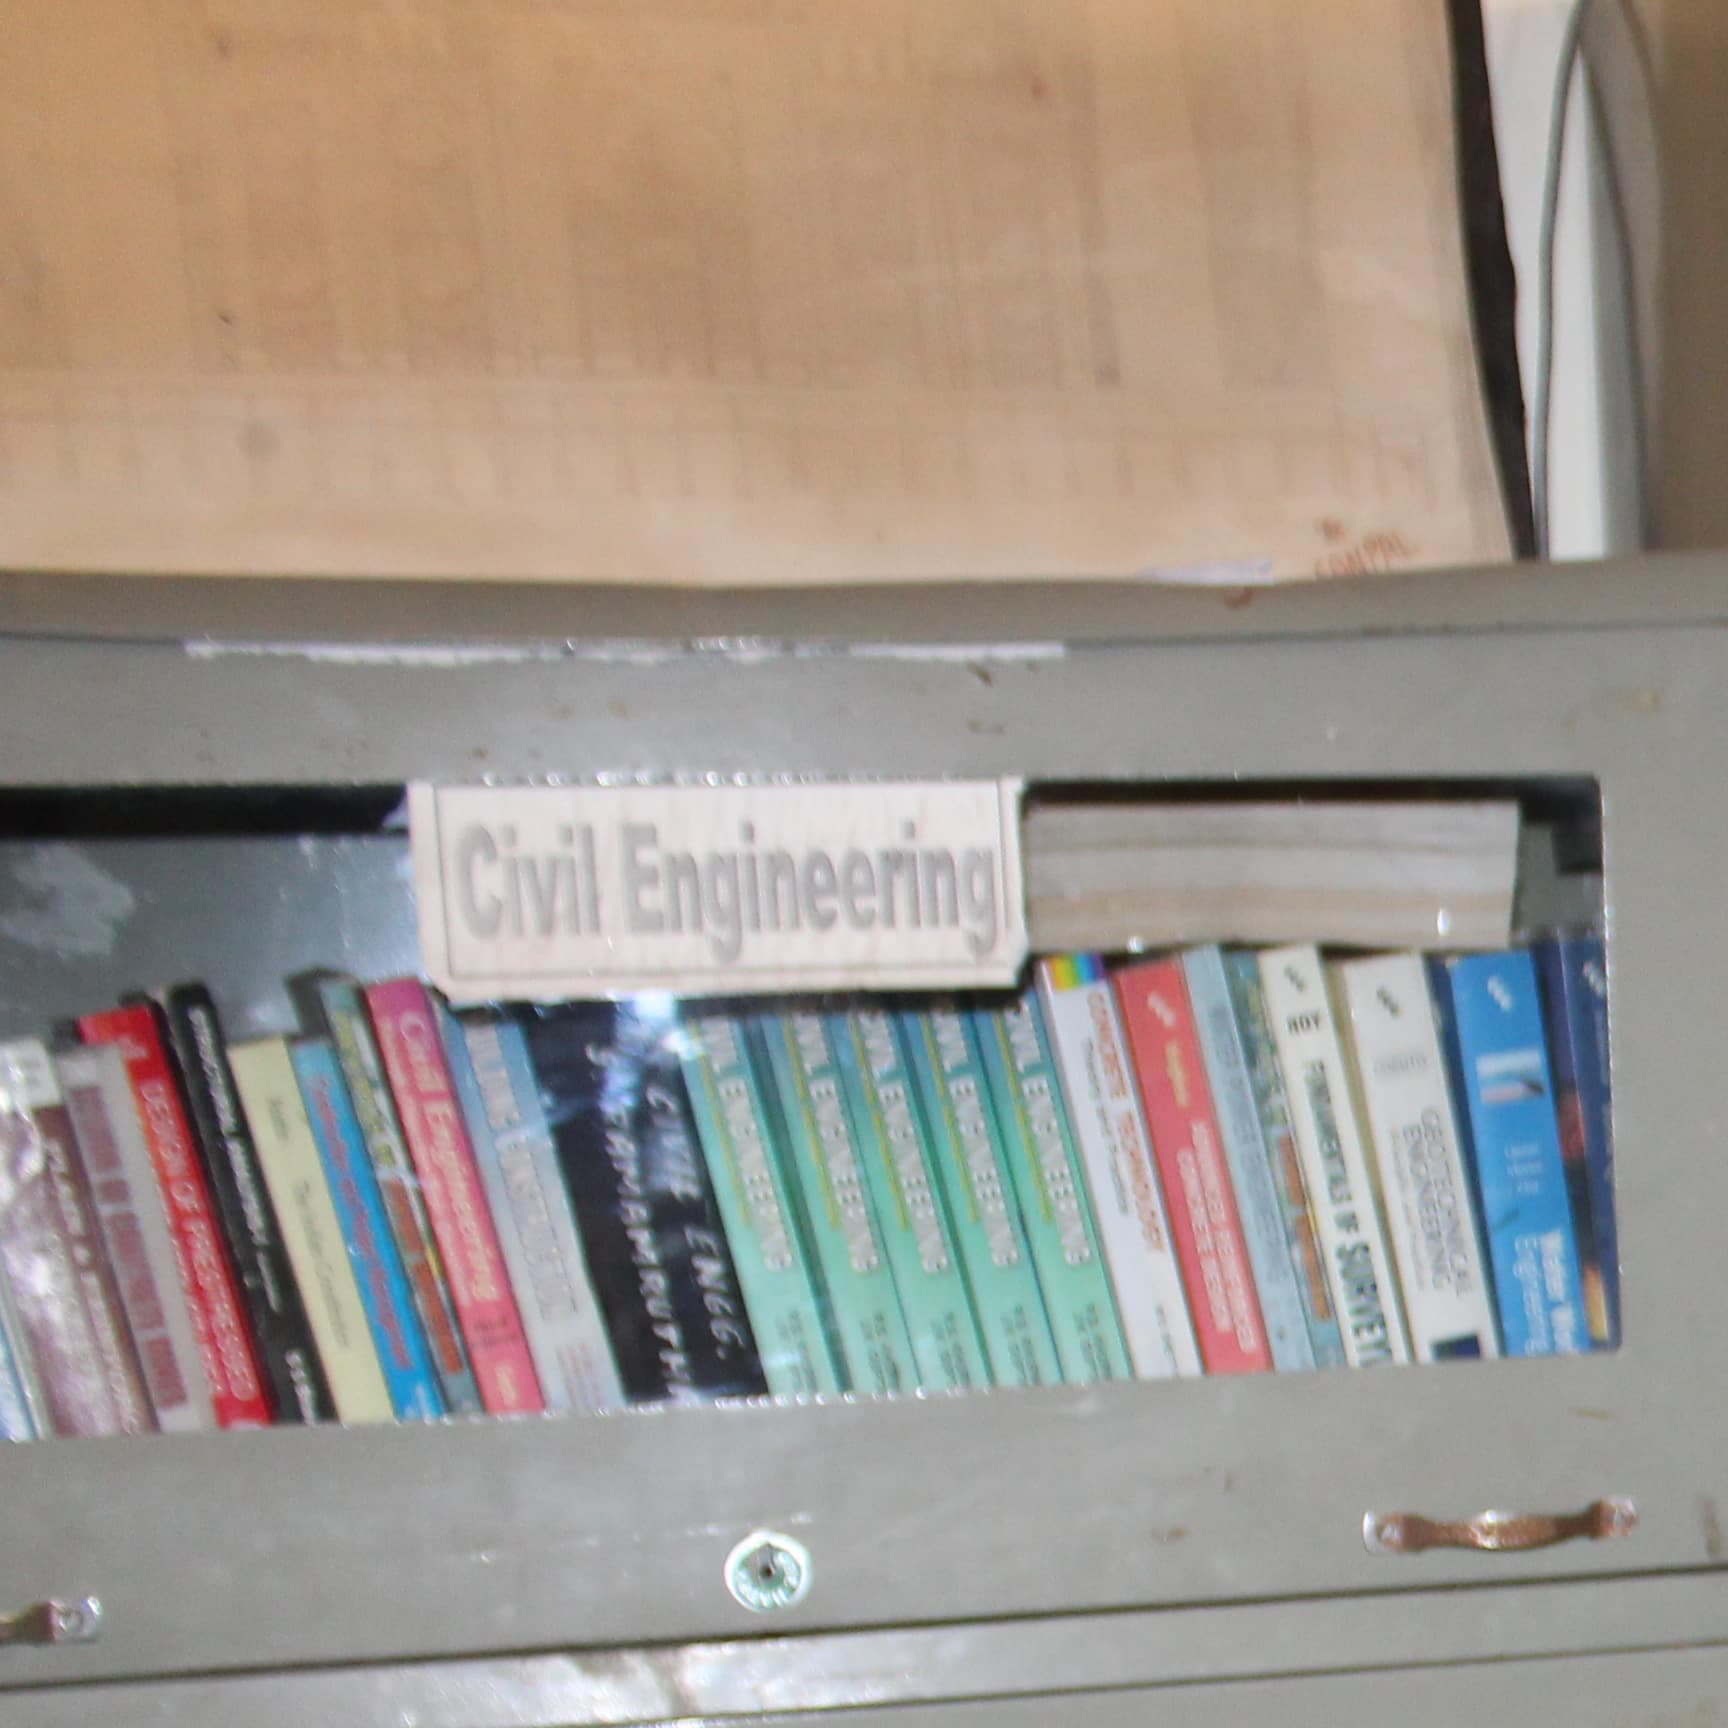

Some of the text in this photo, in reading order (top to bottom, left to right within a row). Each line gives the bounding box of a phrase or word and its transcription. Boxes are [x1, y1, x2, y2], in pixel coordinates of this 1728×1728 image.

[459, 815, 998, 960] Civil Engineering
[140, 1080, 193, 1185] DESIGN
[170, 1182, 202, 1214] OF
[646, 1086, 746, 1362] CIVIL ENGG.
[718, 1078, 793, 1272] ENGINEERING
[808, 1080, 881, 1273] ENGINEERING
[877, 1086, 950, 1274] ENGINEERING
[947, 1080, 1021, 1267] ENGINEERING
[1020, 1076, 1093, 1266] ENGINEERING
